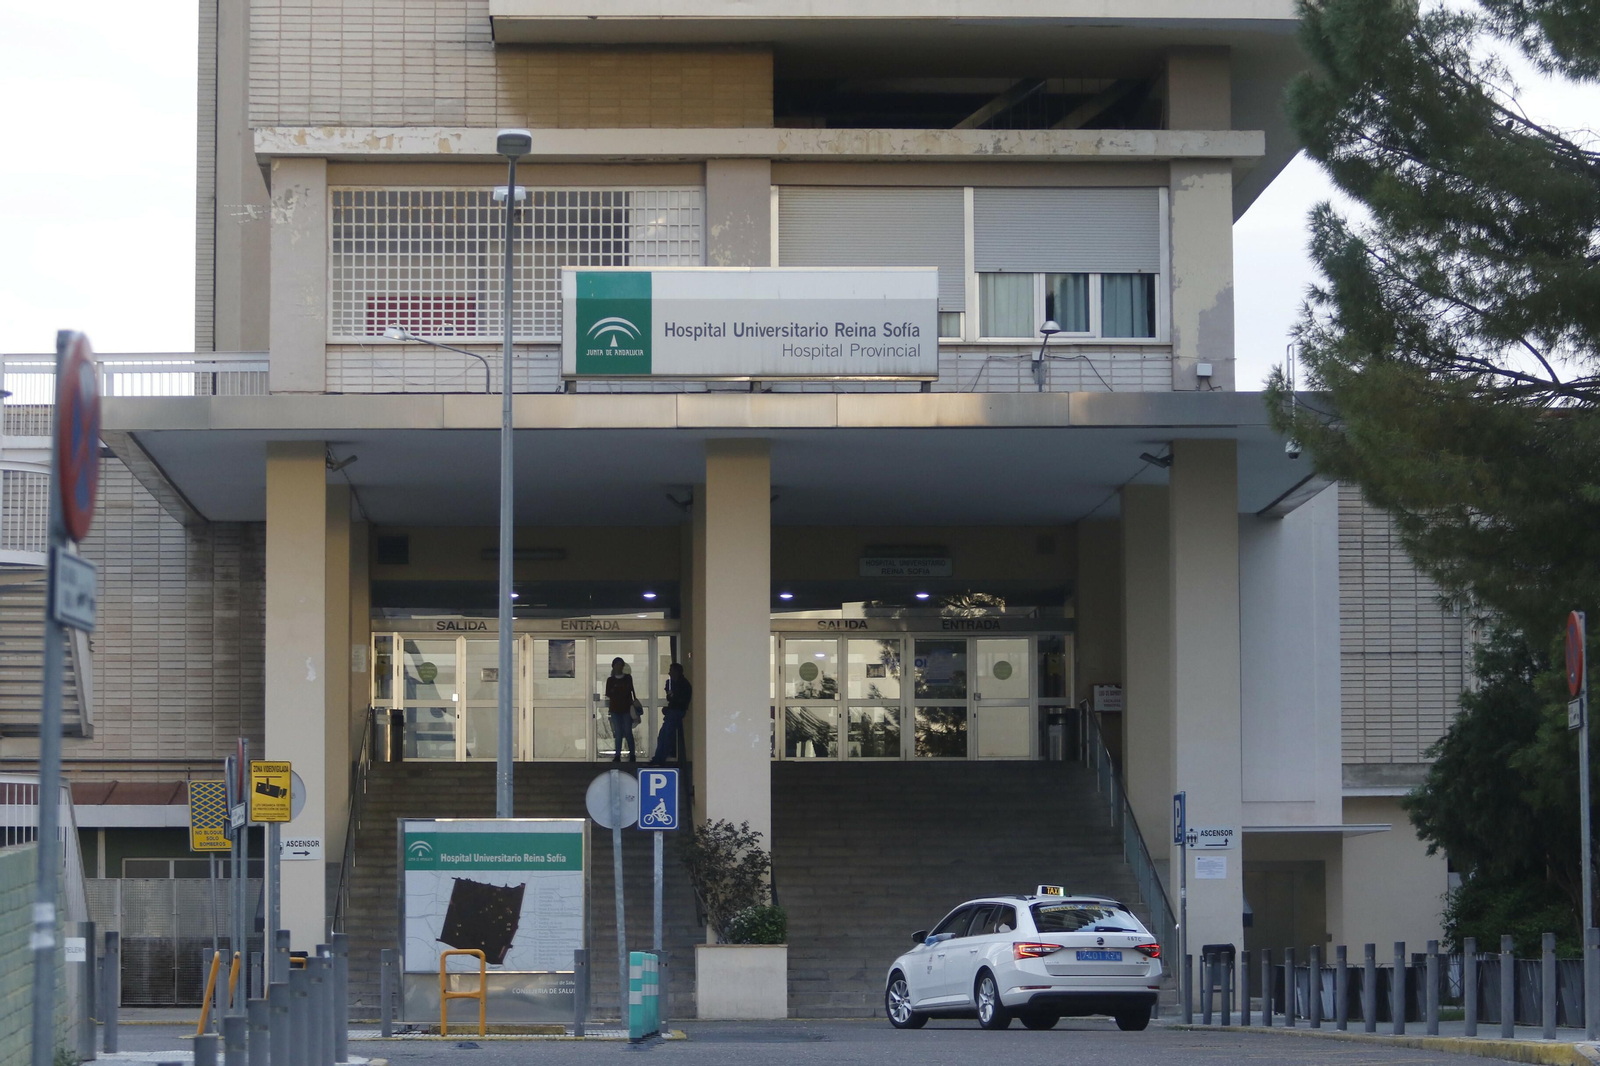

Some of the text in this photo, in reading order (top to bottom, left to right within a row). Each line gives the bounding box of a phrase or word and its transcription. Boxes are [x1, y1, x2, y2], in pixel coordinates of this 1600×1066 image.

[664, 322, 920, 342] Hospital Universitario Reina Sofía
[782, 343, 921, 360] Hospital Provincial
[436, 620, 488, 631] SALIDA
[560, 620, 620, 631] ENTRADA
[817, 620, 868, 630] SALIDA
[942, 620, 1000, 630] ENTRADA
[650, 774, 667, 796] P
[440, 853, 472, 864] Hospital
[473, 853, 522, 863] Universitario
[523, 853, 545, 863] Reina
[1047, 887, 1060, 895] TAXI
